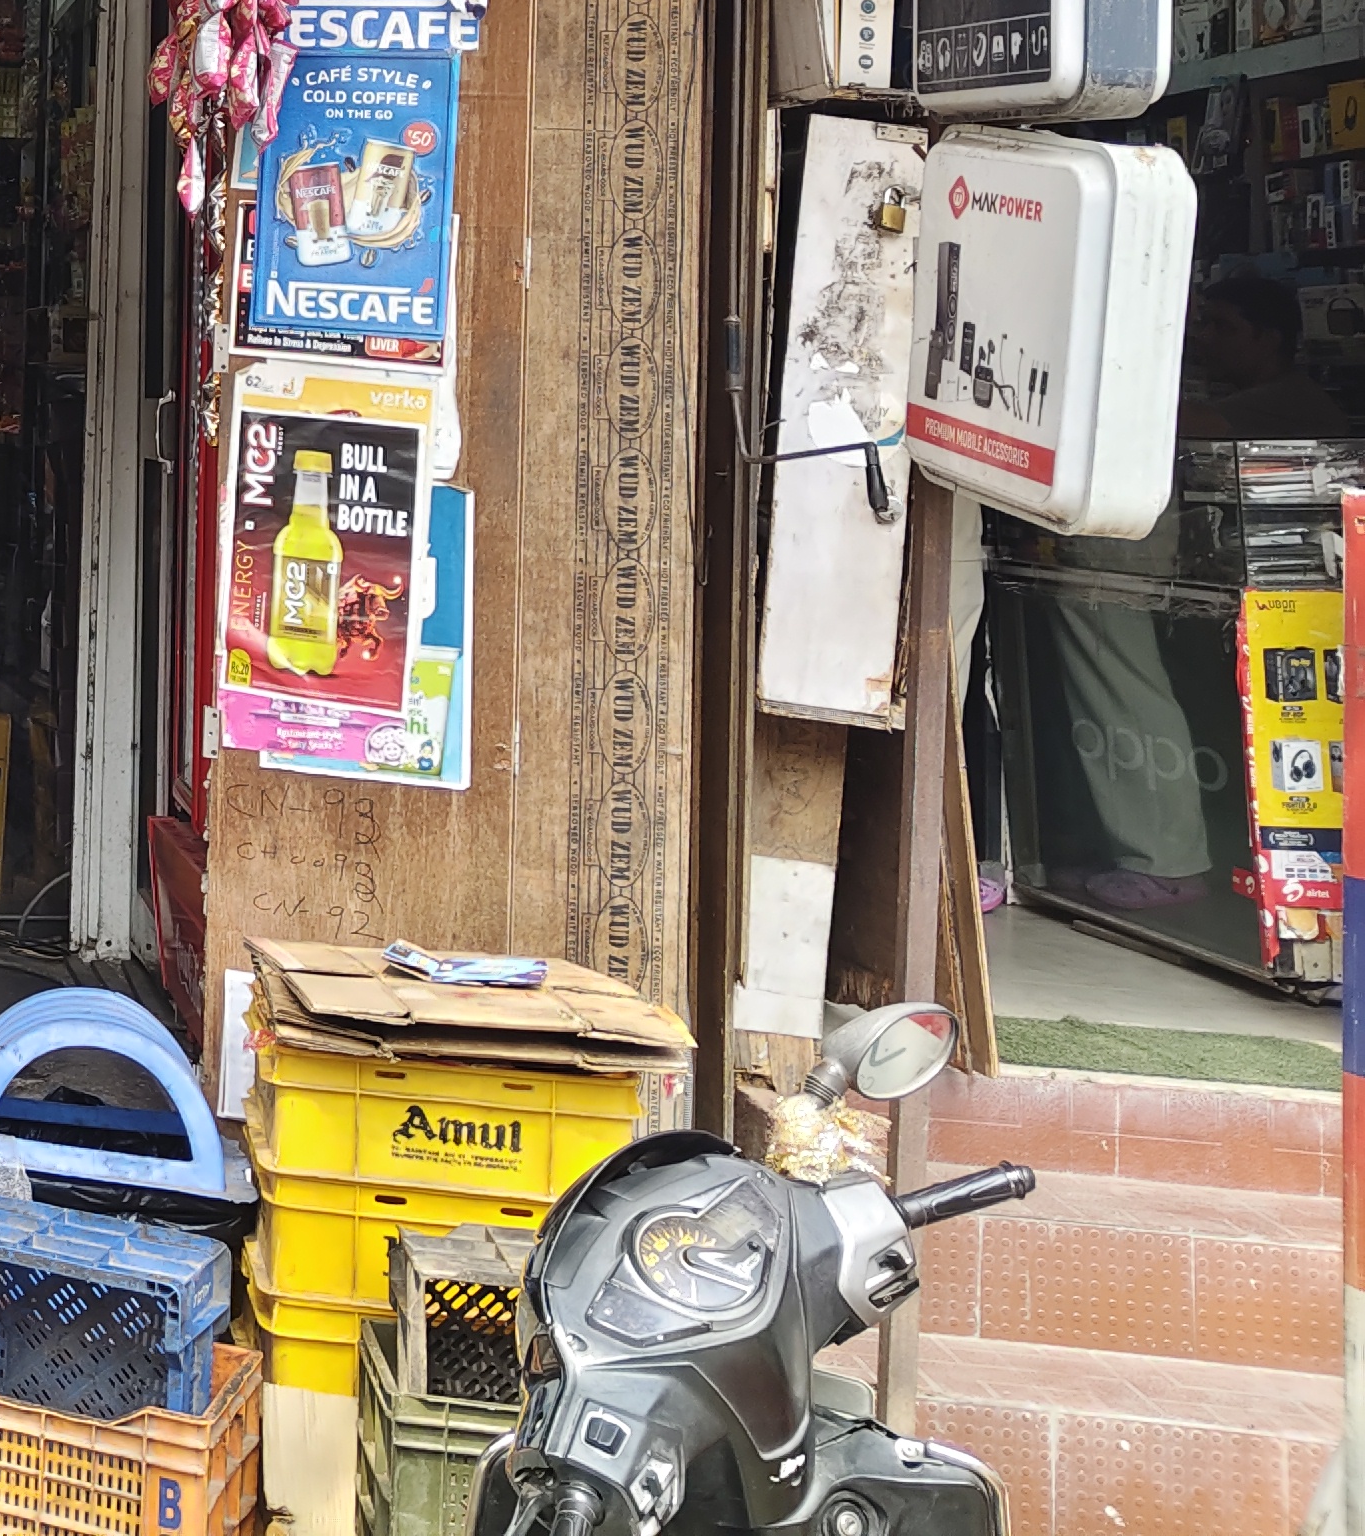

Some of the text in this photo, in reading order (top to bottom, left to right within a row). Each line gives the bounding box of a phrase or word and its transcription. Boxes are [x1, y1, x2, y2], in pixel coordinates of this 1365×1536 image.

[282, 9, 479, 50] ESCAFE
[305, 65, 419, 87] CAFÉ STYLE
[302, 90, 419, 106] COLD COFFEE
[326, 109, 393, 120] ON THE GO
[624, 126, 645, 214] WUD ZEM
[370, 339, 399, 353] LIVER
[370, 389, 427, 409] verka
[619, 344, 640, 433] WUD ZEM
[341, 443, 388, 473] BULL
[924, 417, 1030, 469] PREMIUM MOBILE ACCESSORIES
[243, 423, 277, 506] MC2
[340, 473, 377, 503] IN A
[618, 455, 639, 546] WUD ZEM
[337, 504, 409, 537] BOTTLE
[231, 540, 254, 631] ENERGY
[283, 562, 307, 626] MC2
[610, 790, 633, 881] WUD ZEM
[1306, 888, 1330, 899] airtel
[392, 1105, 522, 1153] Amul
